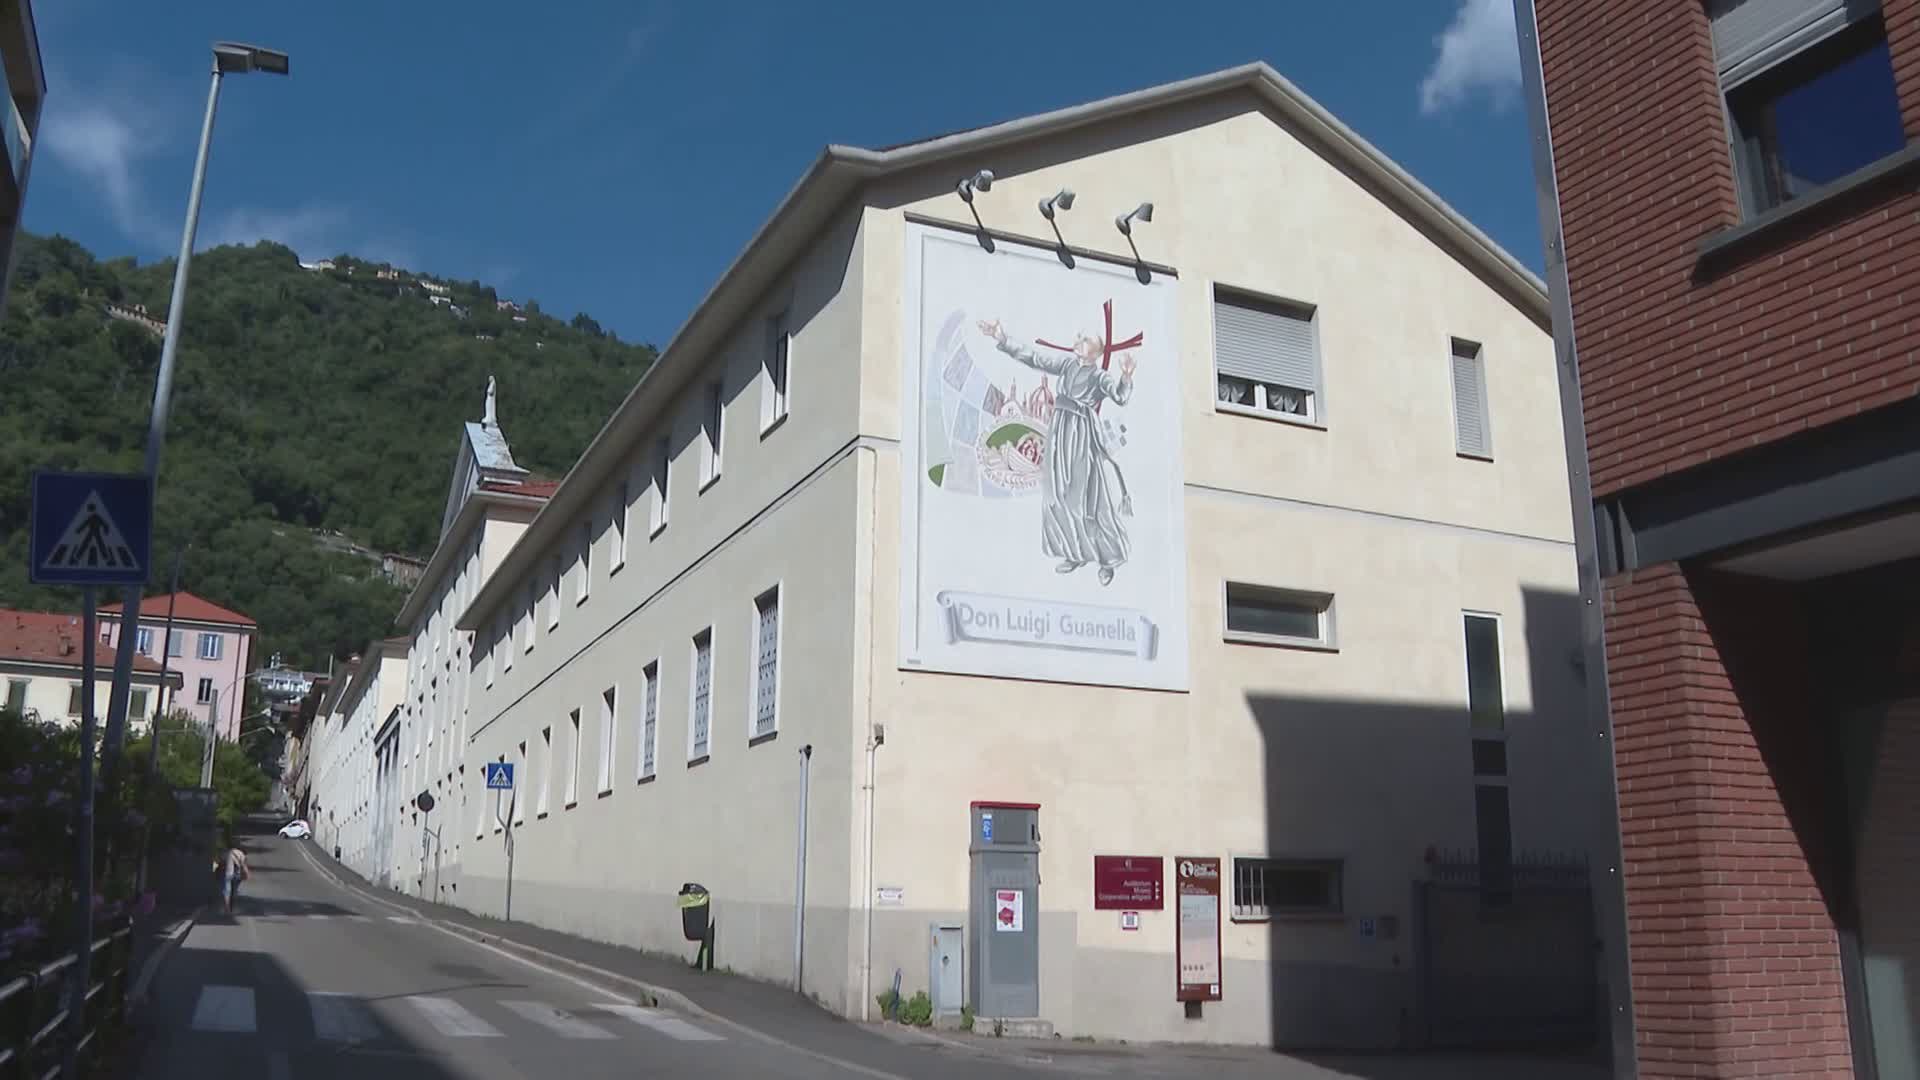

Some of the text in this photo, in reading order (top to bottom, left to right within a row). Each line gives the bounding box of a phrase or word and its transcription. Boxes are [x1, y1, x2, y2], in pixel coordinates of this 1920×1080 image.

[958, 602, 1137, 642] Don Luigi Guanella
